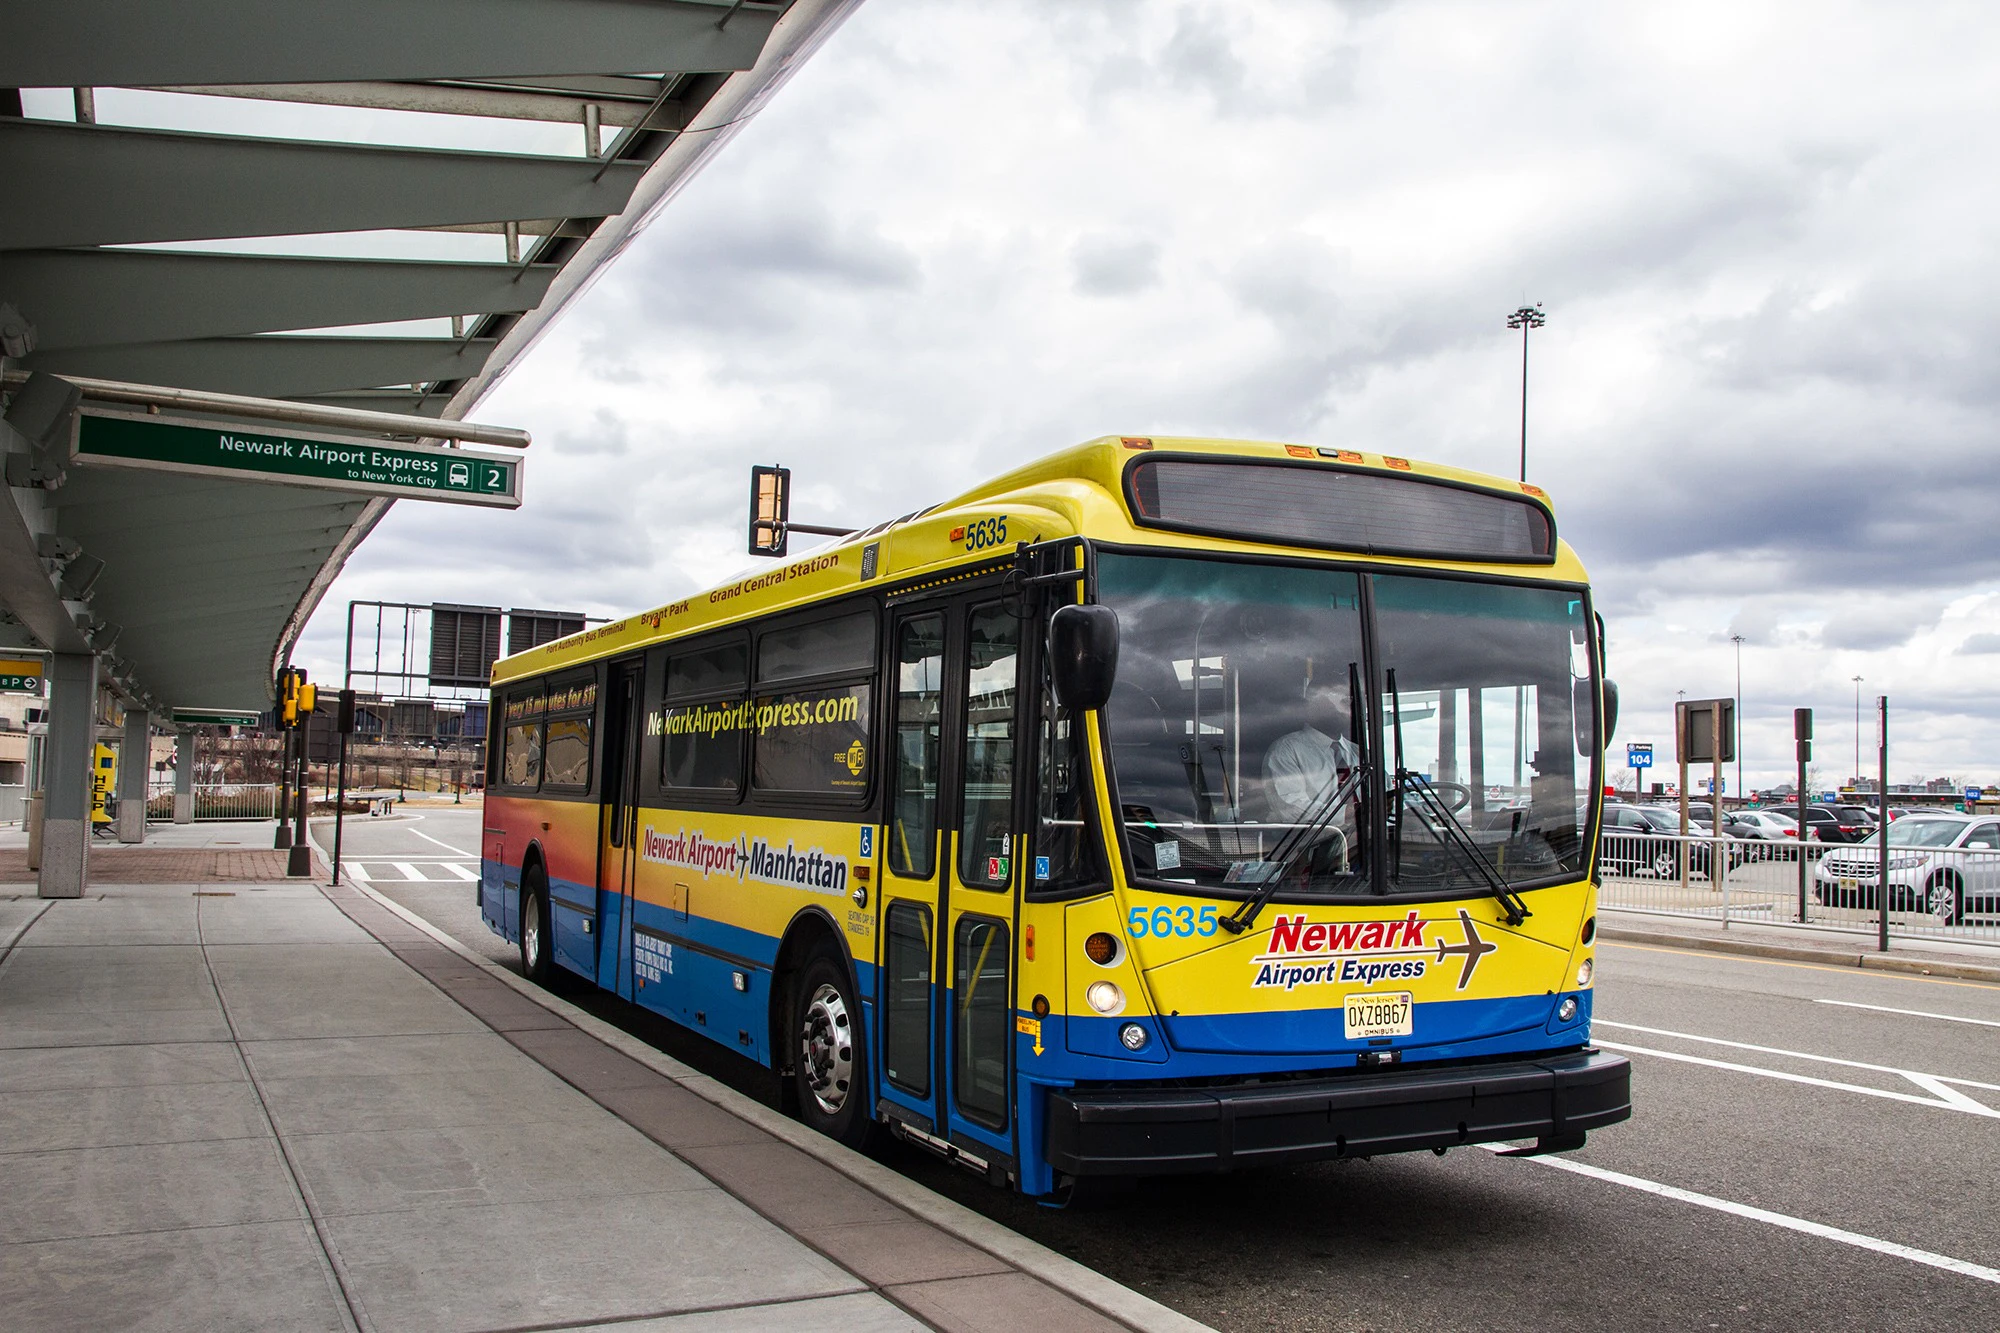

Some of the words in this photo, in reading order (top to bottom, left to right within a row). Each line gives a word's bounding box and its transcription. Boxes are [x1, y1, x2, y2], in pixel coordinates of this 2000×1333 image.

[220, 435, 292, 457] Newark
[300, 445, 365, 465] Airport
[372, 453, 438, 472] Express
[348, 469, 358, 478] to
[362, 470, 386, 480] New
[389, 473, 414, 484] York
[416, 475, 437, 488] City
[487, 470, 500, 488] 2
[965, 514, 1007, 551] 5635
[709, 583, 741, 604] Grand
[744, 567, 786, 593] Central
[789, 554, 839, 580] Station
[641, 609, 667, 625] Bryant
[670, 600, 689, 616] Park
[546, 645, 557, 654] Port
[558, 636, 584, 651] Authority
[586, 631, 597, 643] Bus
[598, 620, 626, 638] Terminal
[567, 687, 582, 708] for
[834, 752, 846, 763] FREE
[1630, 755, 1650, 764] 104
[93, 775, 106, 811] HELP
[643, 829, 685, 863] Newark
[687, 835, 736, 876] Airport
[750, 842, 846, 890] Manhattan
[1126, 906, 1219, 939] 5635
[1268, 912, 1429, 954] Newark
[1254, 962, 1336, 988] Airport
[1340, 960, 1425, 985] Express
[1376, 996, 1394, 1004] Jersey
[1364, 1028, 1394, 1036] OMNIBUS
